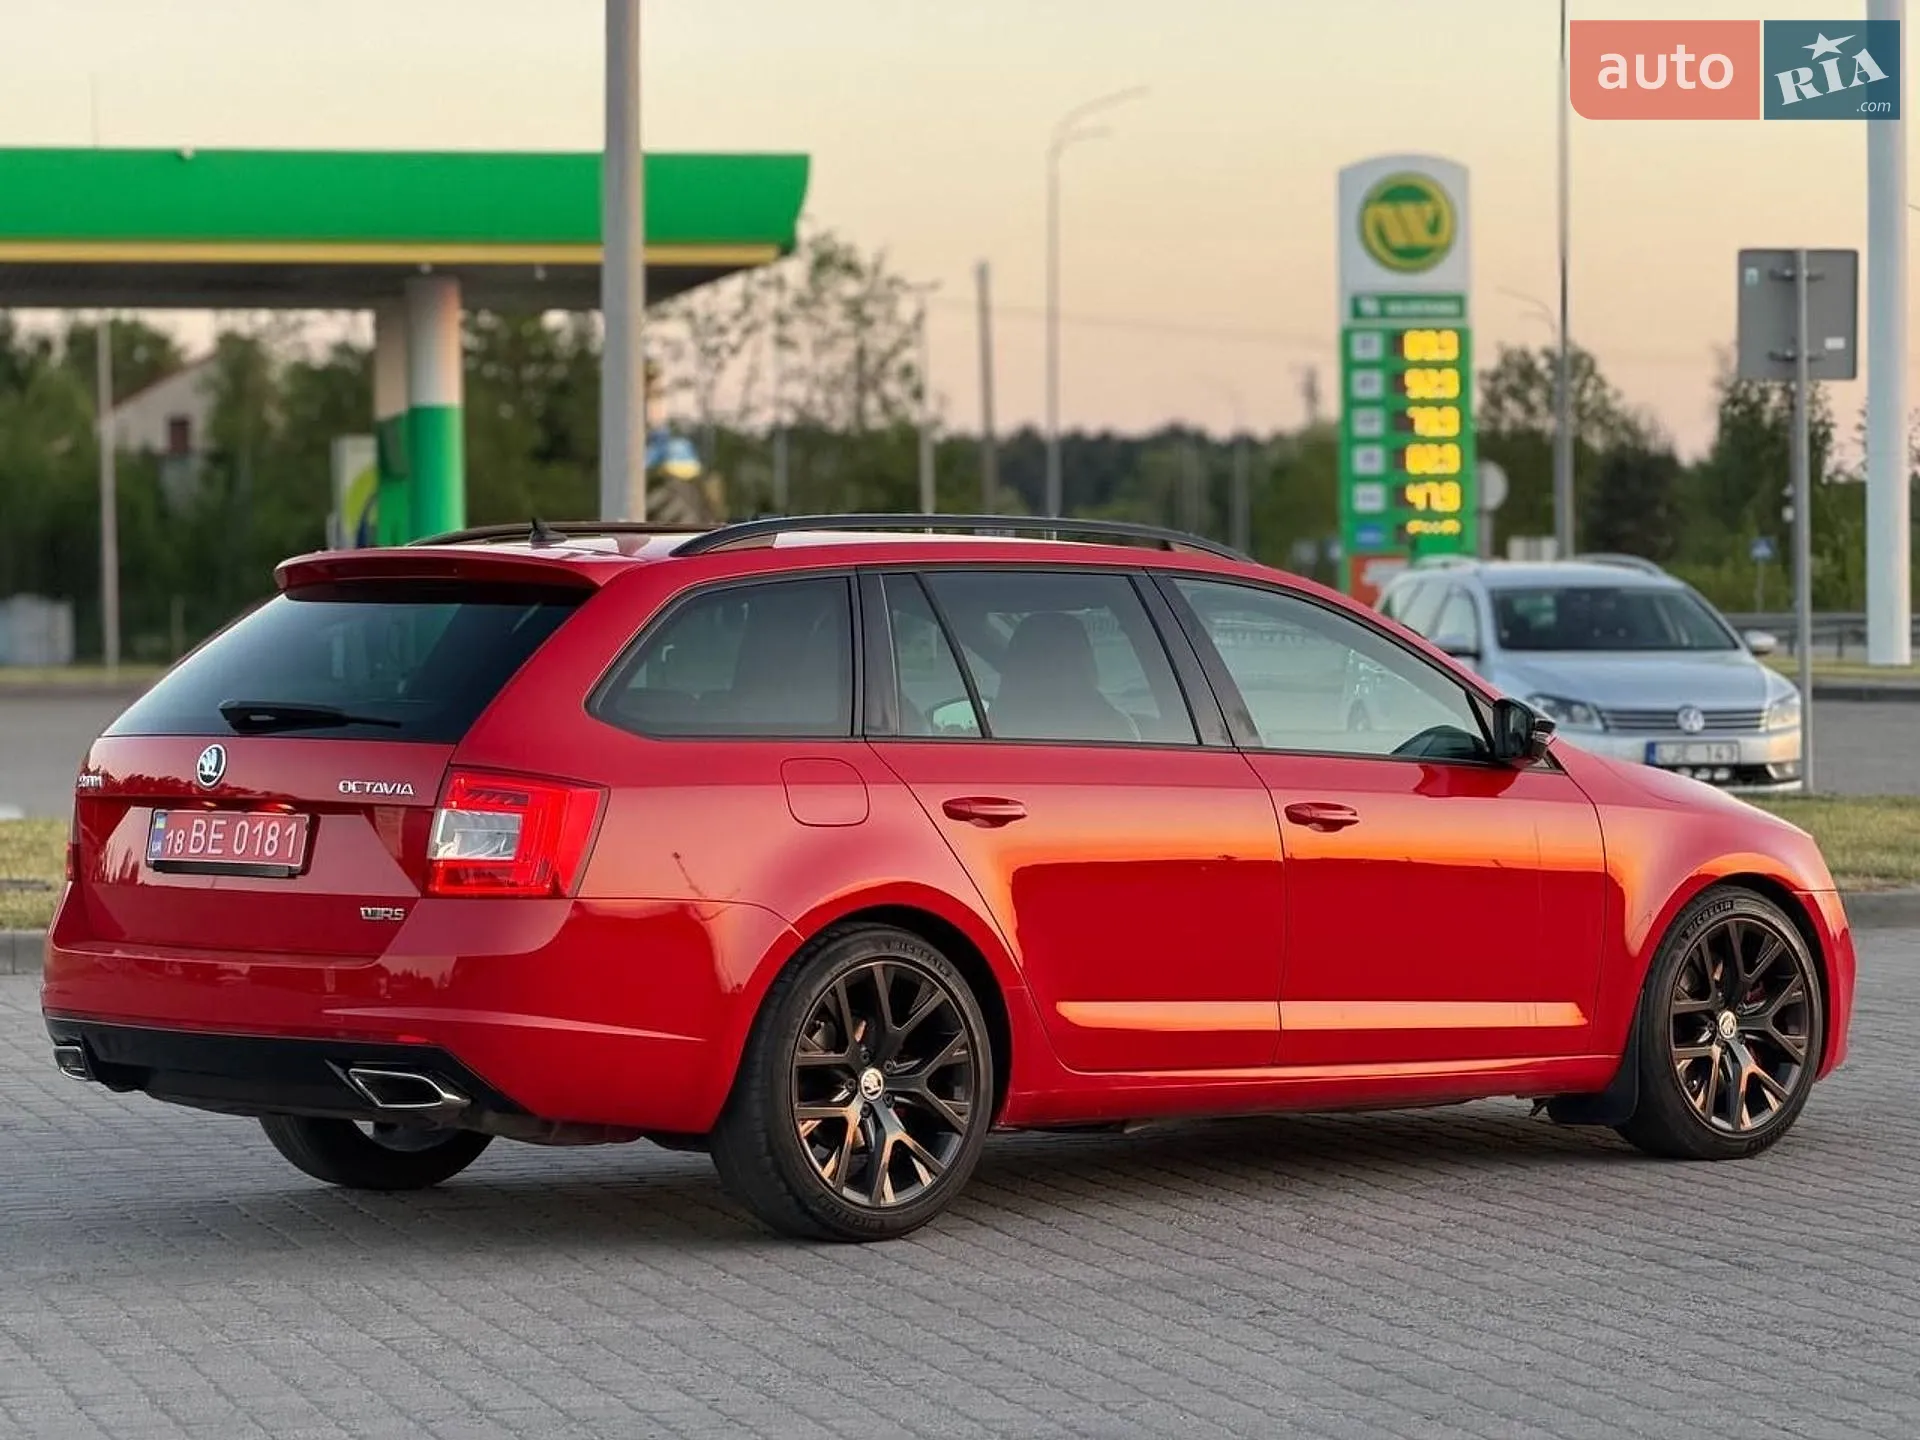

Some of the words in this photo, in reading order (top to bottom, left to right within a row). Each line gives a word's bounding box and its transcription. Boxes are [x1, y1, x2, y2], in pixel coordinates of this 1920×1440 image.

[338, 779, 414, 796] OCTAVIA
[166, 829, 185, 854] 18
[189, 819, 227, 855] BE
[233, 820, 297, 858] 0181
